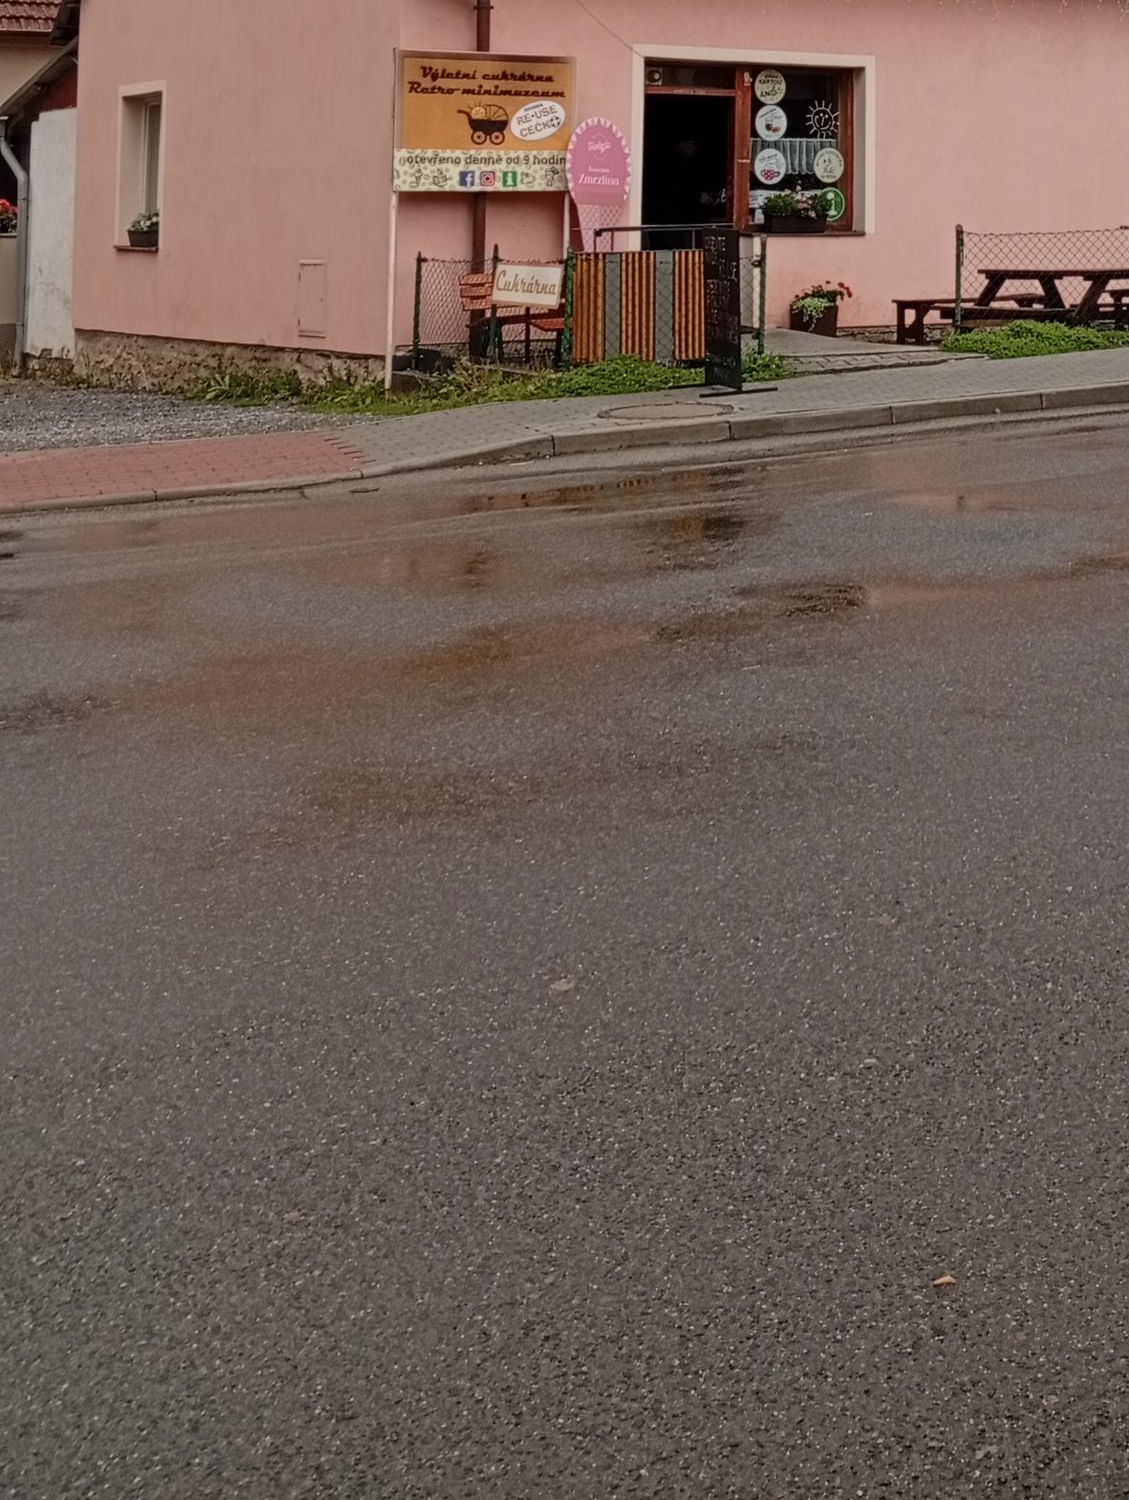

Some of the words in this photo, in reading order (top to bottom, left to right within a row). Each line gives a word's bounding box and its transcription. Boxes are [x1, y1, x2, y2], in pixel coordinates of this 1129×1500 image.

[420, 66, 477, 82] Výletní
[482, 70, 554, 83] cukrárna
[408, 81, 459, 94] Retro
[461, 84, 566, 98] minimuzeum
[406, 153, 461, 165] otevřeno
[464, 154, 503, 165] denně
[505, 155, 520, 165] od
[523, 155, 530, 166] 9
[532, 155, 566, 165] hodin
[496, 269, 557, 296] Cukrárna
